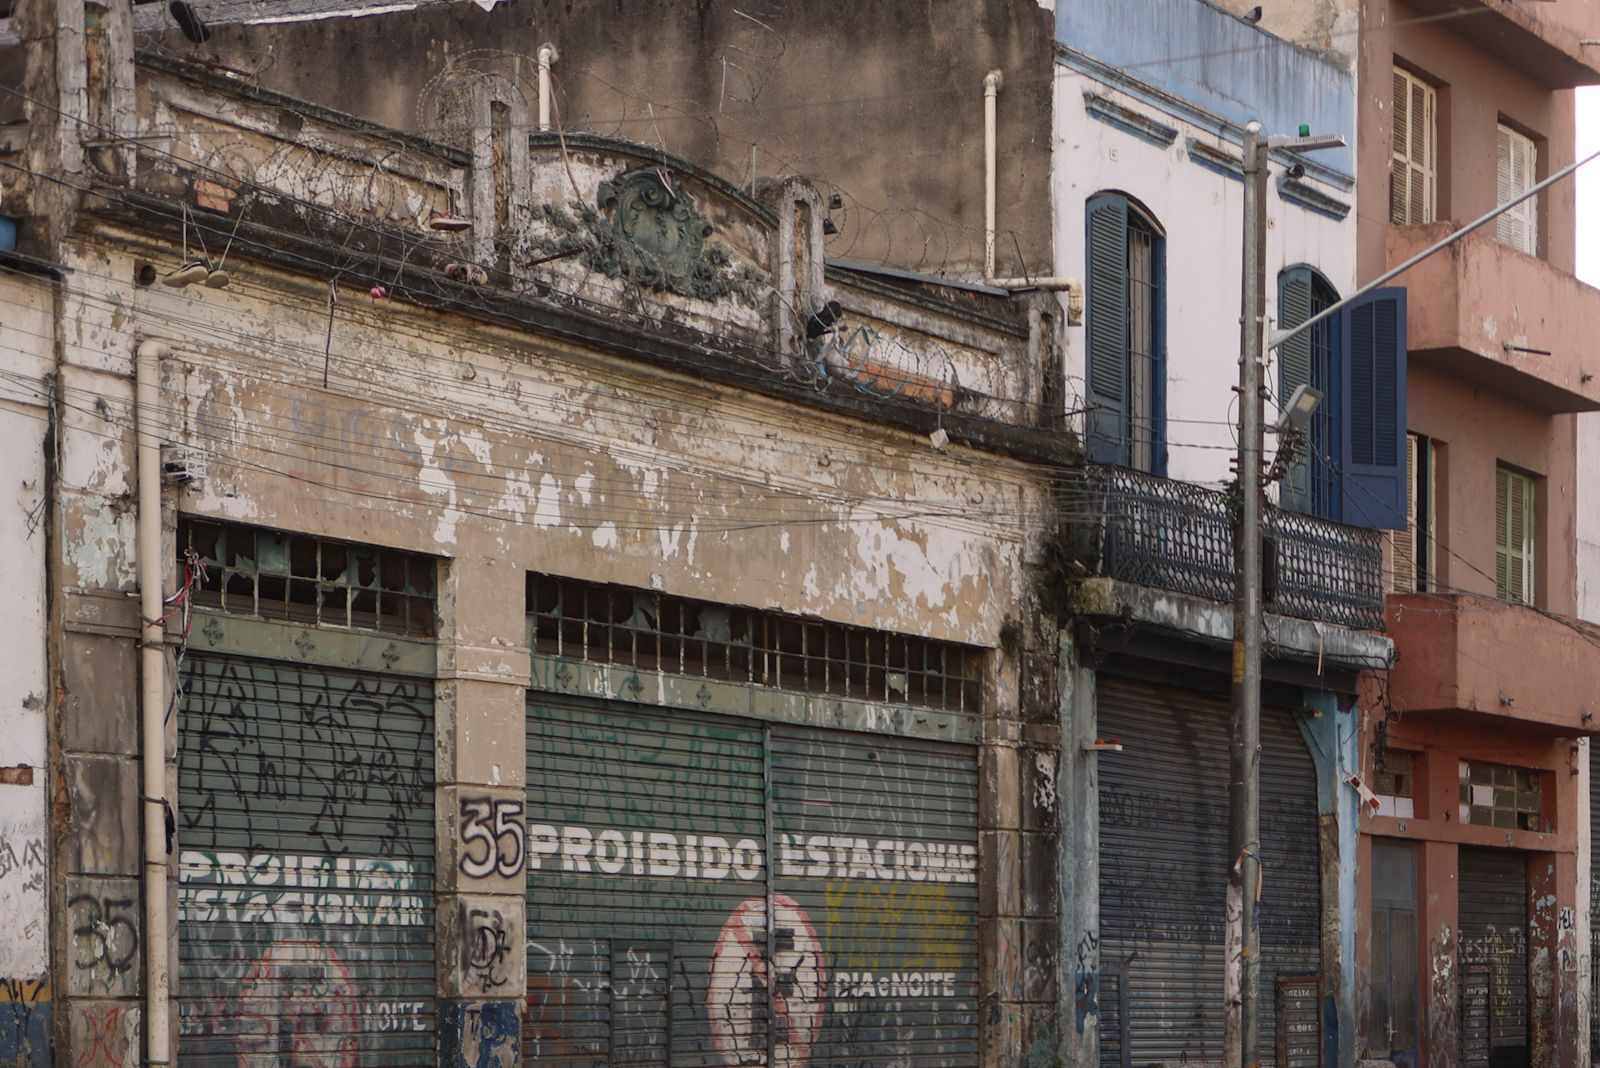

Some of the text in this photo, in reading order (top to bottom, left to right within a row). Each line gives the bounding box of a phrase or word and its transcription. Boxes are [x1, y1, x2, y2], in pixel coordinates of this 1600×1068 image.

[458, 795, 526, 879] 35
[528, 823, 977, 883] PROIBIDO ESTACIONAR
[834, 971, 876, 998] DIA
[892, 972, 957, 998] NOITE
